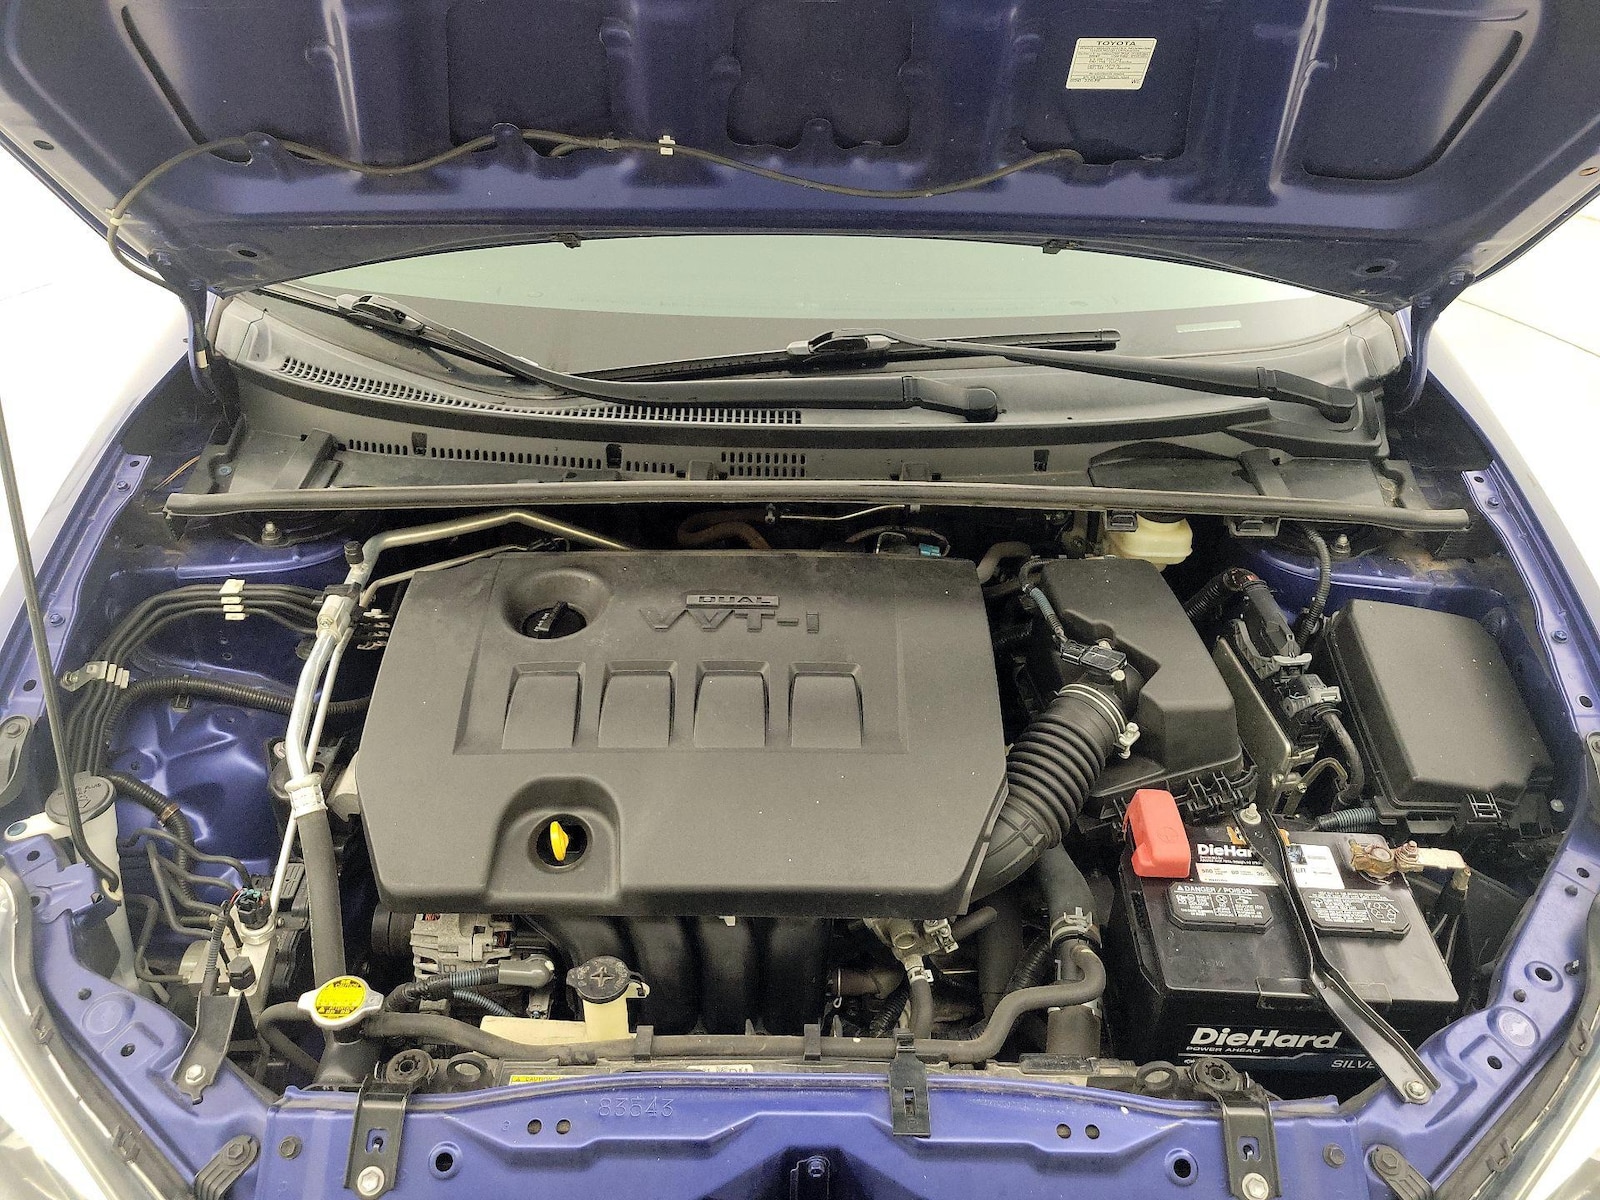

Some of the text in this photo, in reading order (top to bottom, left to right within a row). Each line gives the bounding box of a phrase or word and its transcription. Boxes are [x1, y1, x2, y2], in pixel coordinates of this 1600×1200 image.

[698, 596, 771, 604] DUAL
[1196, 843, 1254, 858] DieHar
[1184, 885, 1217, 893] DANGER
[1190, 1027, 1343, 1049] DieHard
[1331, 1059, 1376, 1069] SILVE
[598, 1098, 674, 1117] 83543
